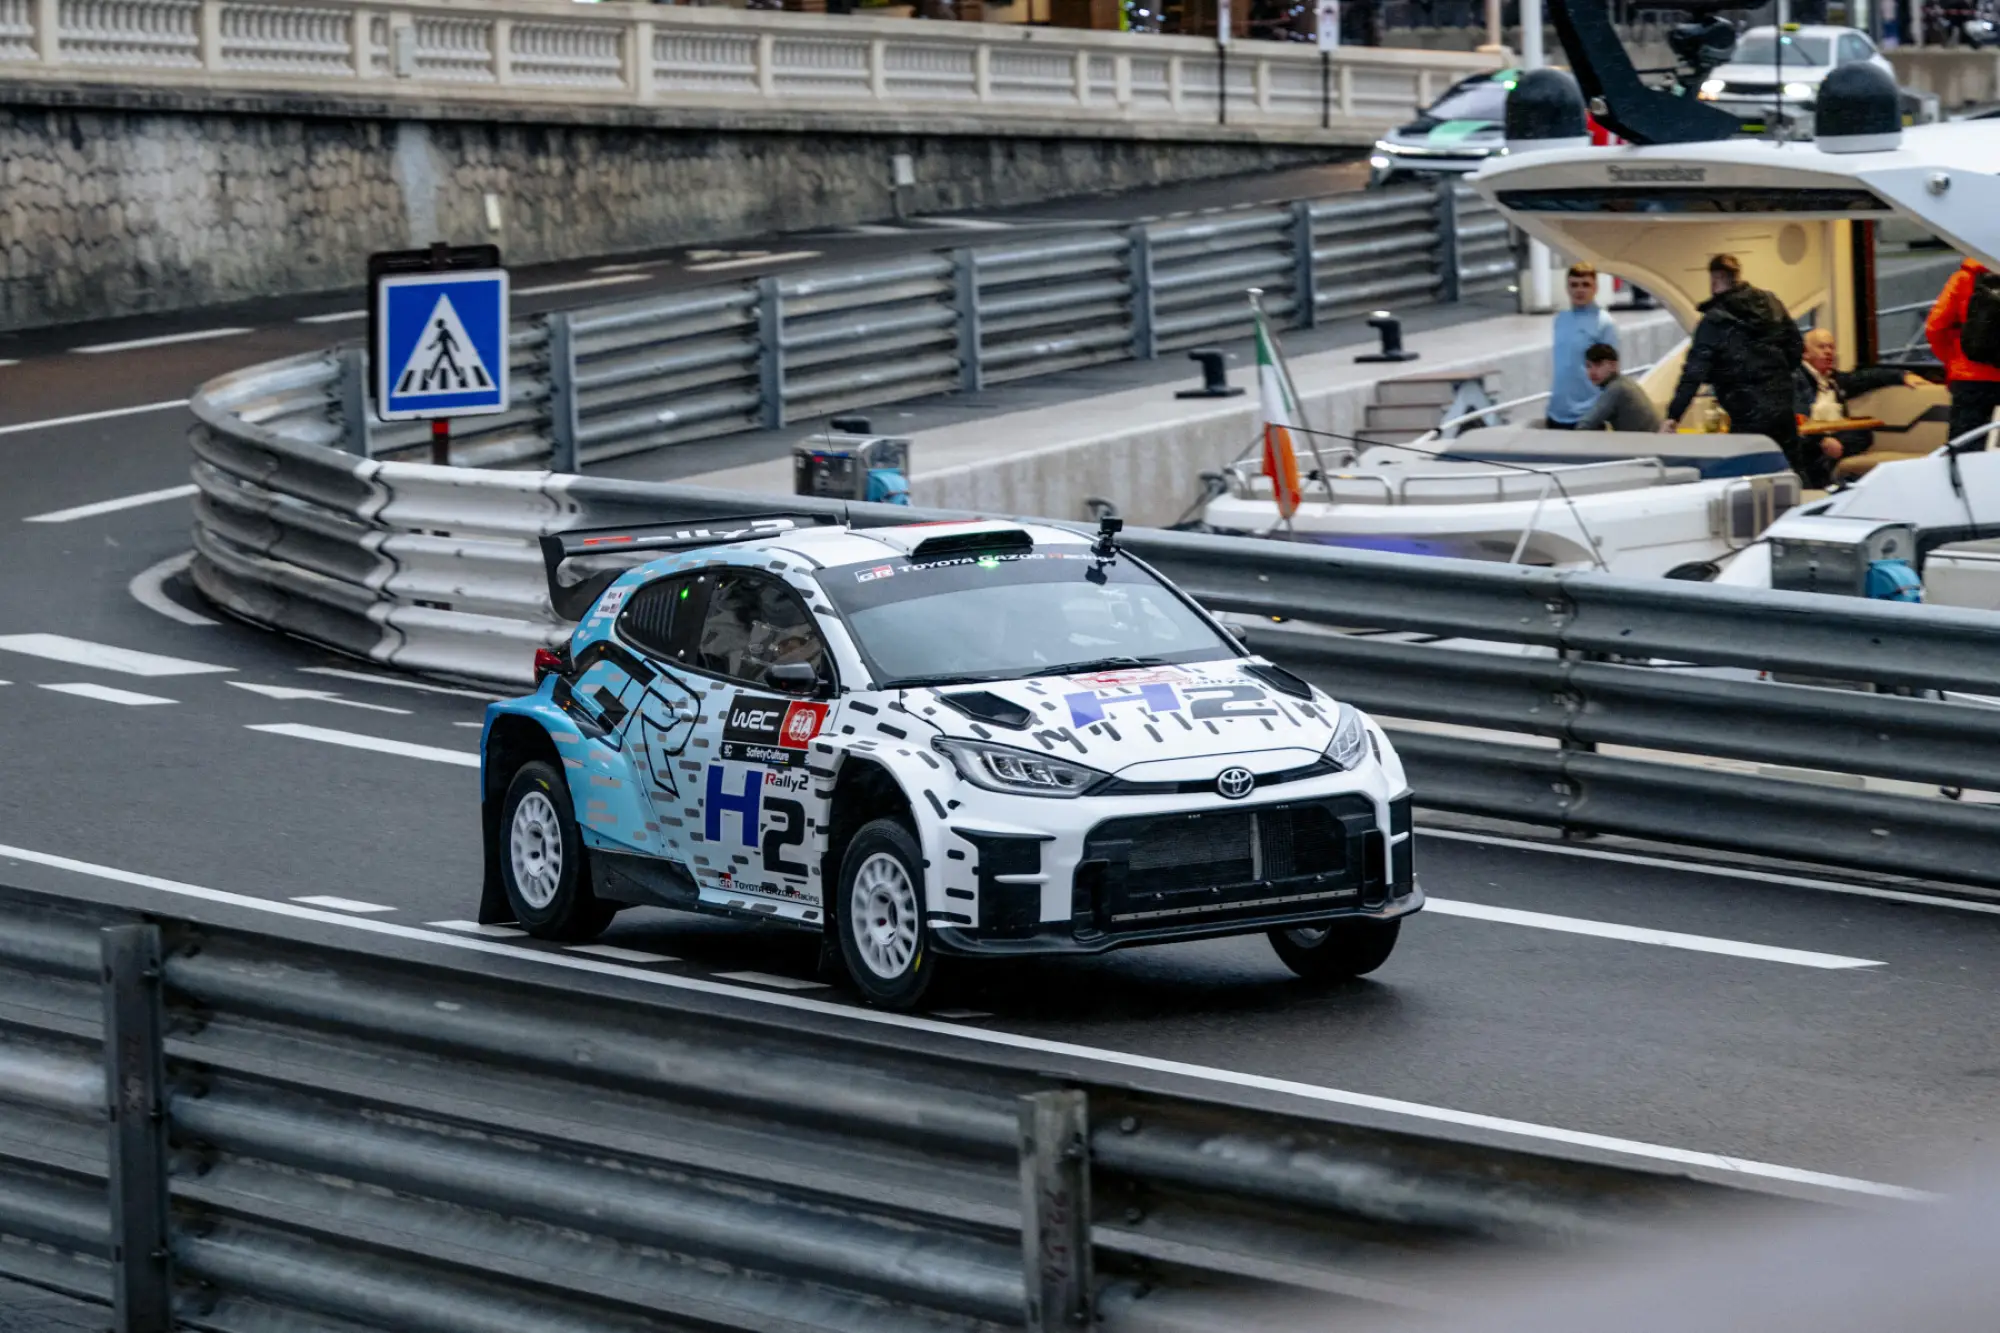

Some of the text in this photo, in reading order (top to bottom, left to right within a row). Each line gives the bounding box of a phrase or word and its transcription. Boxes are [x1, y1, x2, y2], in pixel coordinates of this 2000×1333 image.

[857, 566, 894, 582] GR
[897, 556, 974, 573] TOYOTA
[978, 553, 1045, 563] GAZOO
[1064, 683, 1278, 729] H2
[731, 708, 779, 731] WRC
[746, 747, 790, 761] SafetyCulture
[765, 772, 809, 792] Rally2
[734, 880, 764, 893] TOYOTA
[793, 890, 820, 904] Racing
